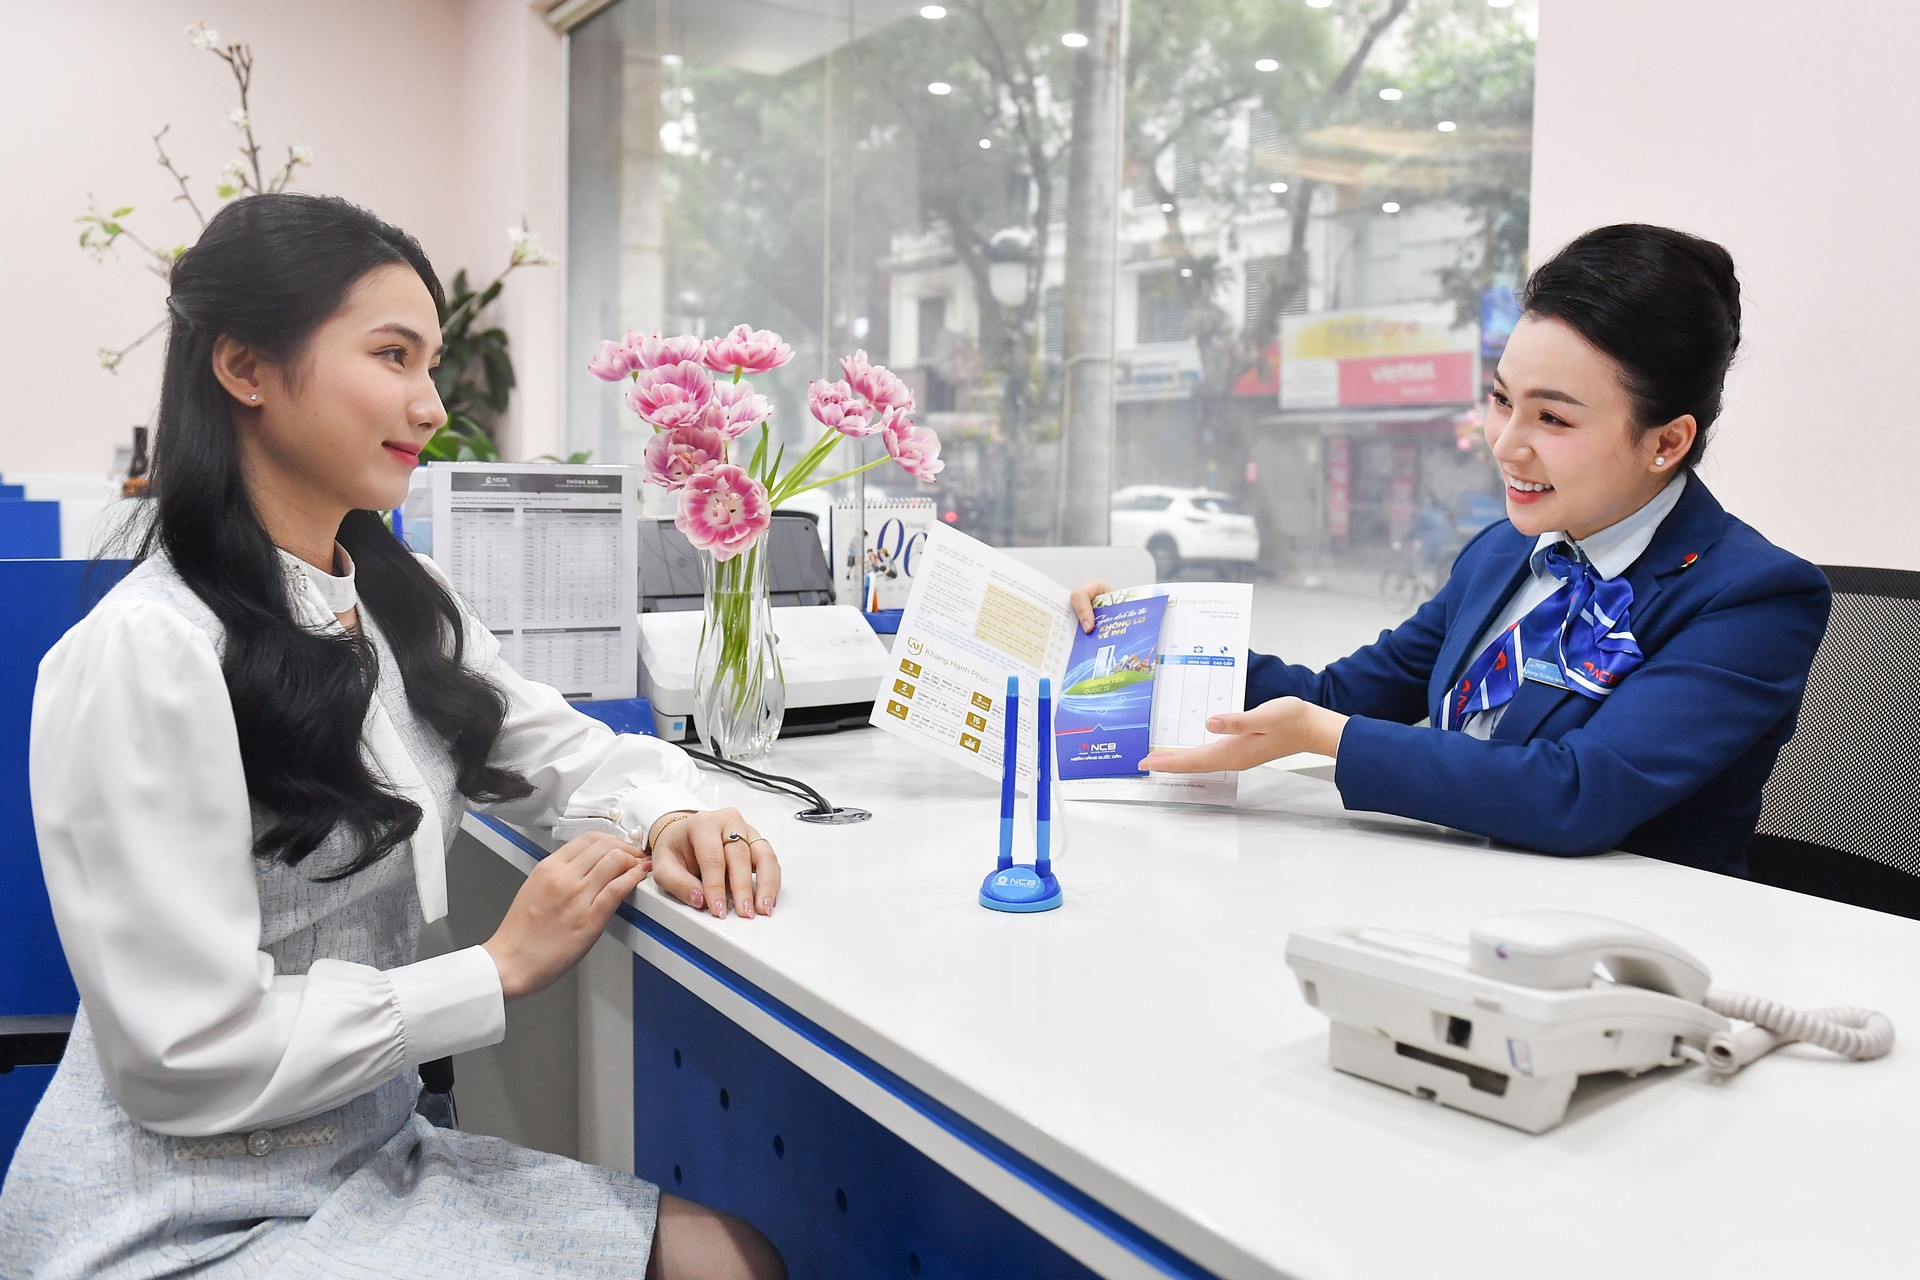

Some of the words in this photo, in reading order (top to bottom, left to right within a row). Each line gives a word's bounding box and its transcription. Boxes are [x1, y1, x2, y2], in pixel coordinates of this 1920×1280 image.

[925, 648, 949, 666] Khang
[949, 660, 970, 675] Hạnh
[907, 663, 915, 671] 3
[901, 683, 908, 692] 2
[895, 704, 901, 712] 6
[972, 715, 981, 725] 15
[1090, 742, 1117, 752] NCB
[1009, 877, 1036, 886] NCB
